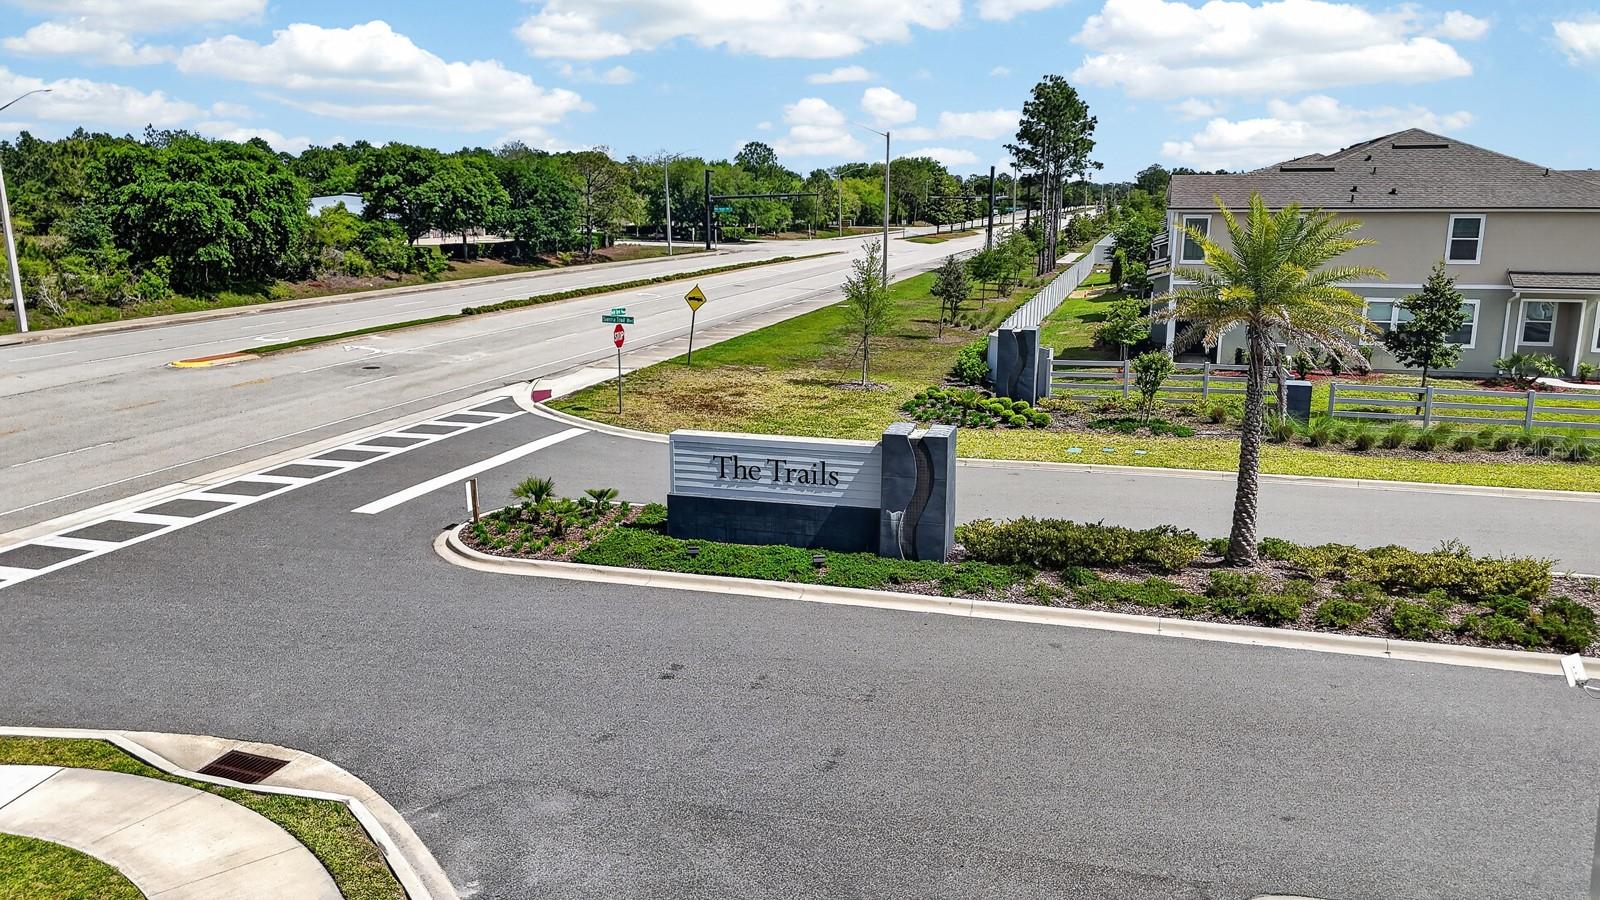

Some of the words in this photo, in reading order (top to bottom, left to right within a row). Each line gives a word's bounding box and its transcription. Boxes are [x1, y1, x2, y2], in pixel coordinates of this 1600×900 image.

[614, 331, 624, 341] STOP
[712, 455, 761, 481] The
[766, 458, 839, 487] Trails
